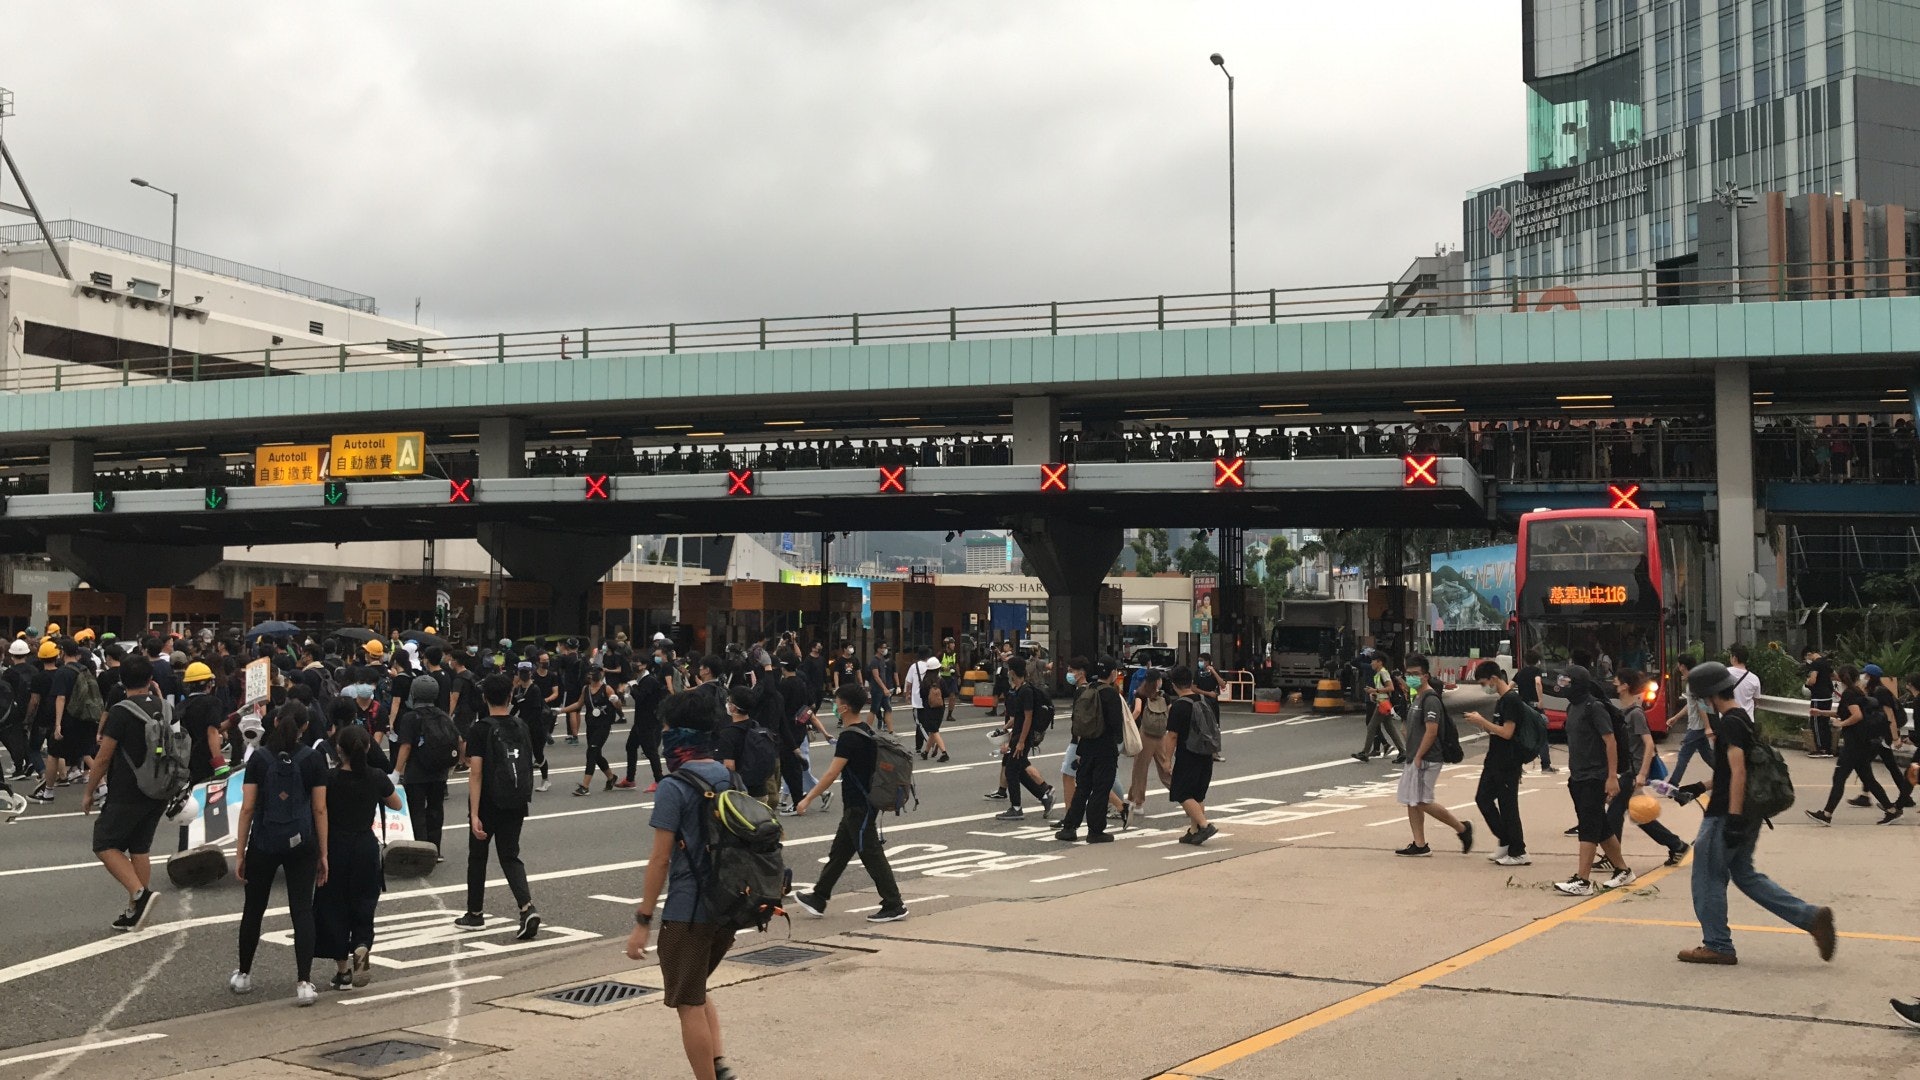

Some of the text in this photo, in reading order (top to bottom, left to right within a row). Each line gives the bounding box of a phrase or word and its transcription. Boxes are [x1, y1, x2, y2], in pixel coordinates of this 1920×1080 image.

[1514, 192, 1540, 207] SCHOOL
[1552, 182, 1575, 196] HOTEL
[1578, 176, 1594, 188] AND
[1595, 167, 1629, 184] TOURISM
[1629, 149, 1686, 174] MANAGEMENT
[1526, 213, 1541, 225] AND
[1541, 208, 1557, 221] MRS
[1557, 203, 1578, 216] CHAN
[1578, 197, 1600, 210] CHAK
[1600, 194, 1612, 204] FU
[1611, 183, 1648, 200] BUILDING
[344, 439, 385, 449] Autotoll
[268, 452, 307, 463] Autotoll
[337, 454, 393, 471] 自動繳費
[260, 466, 313, 482] 自動繳費
[1550, 586, 1627, 603] 慈雲山中 116
